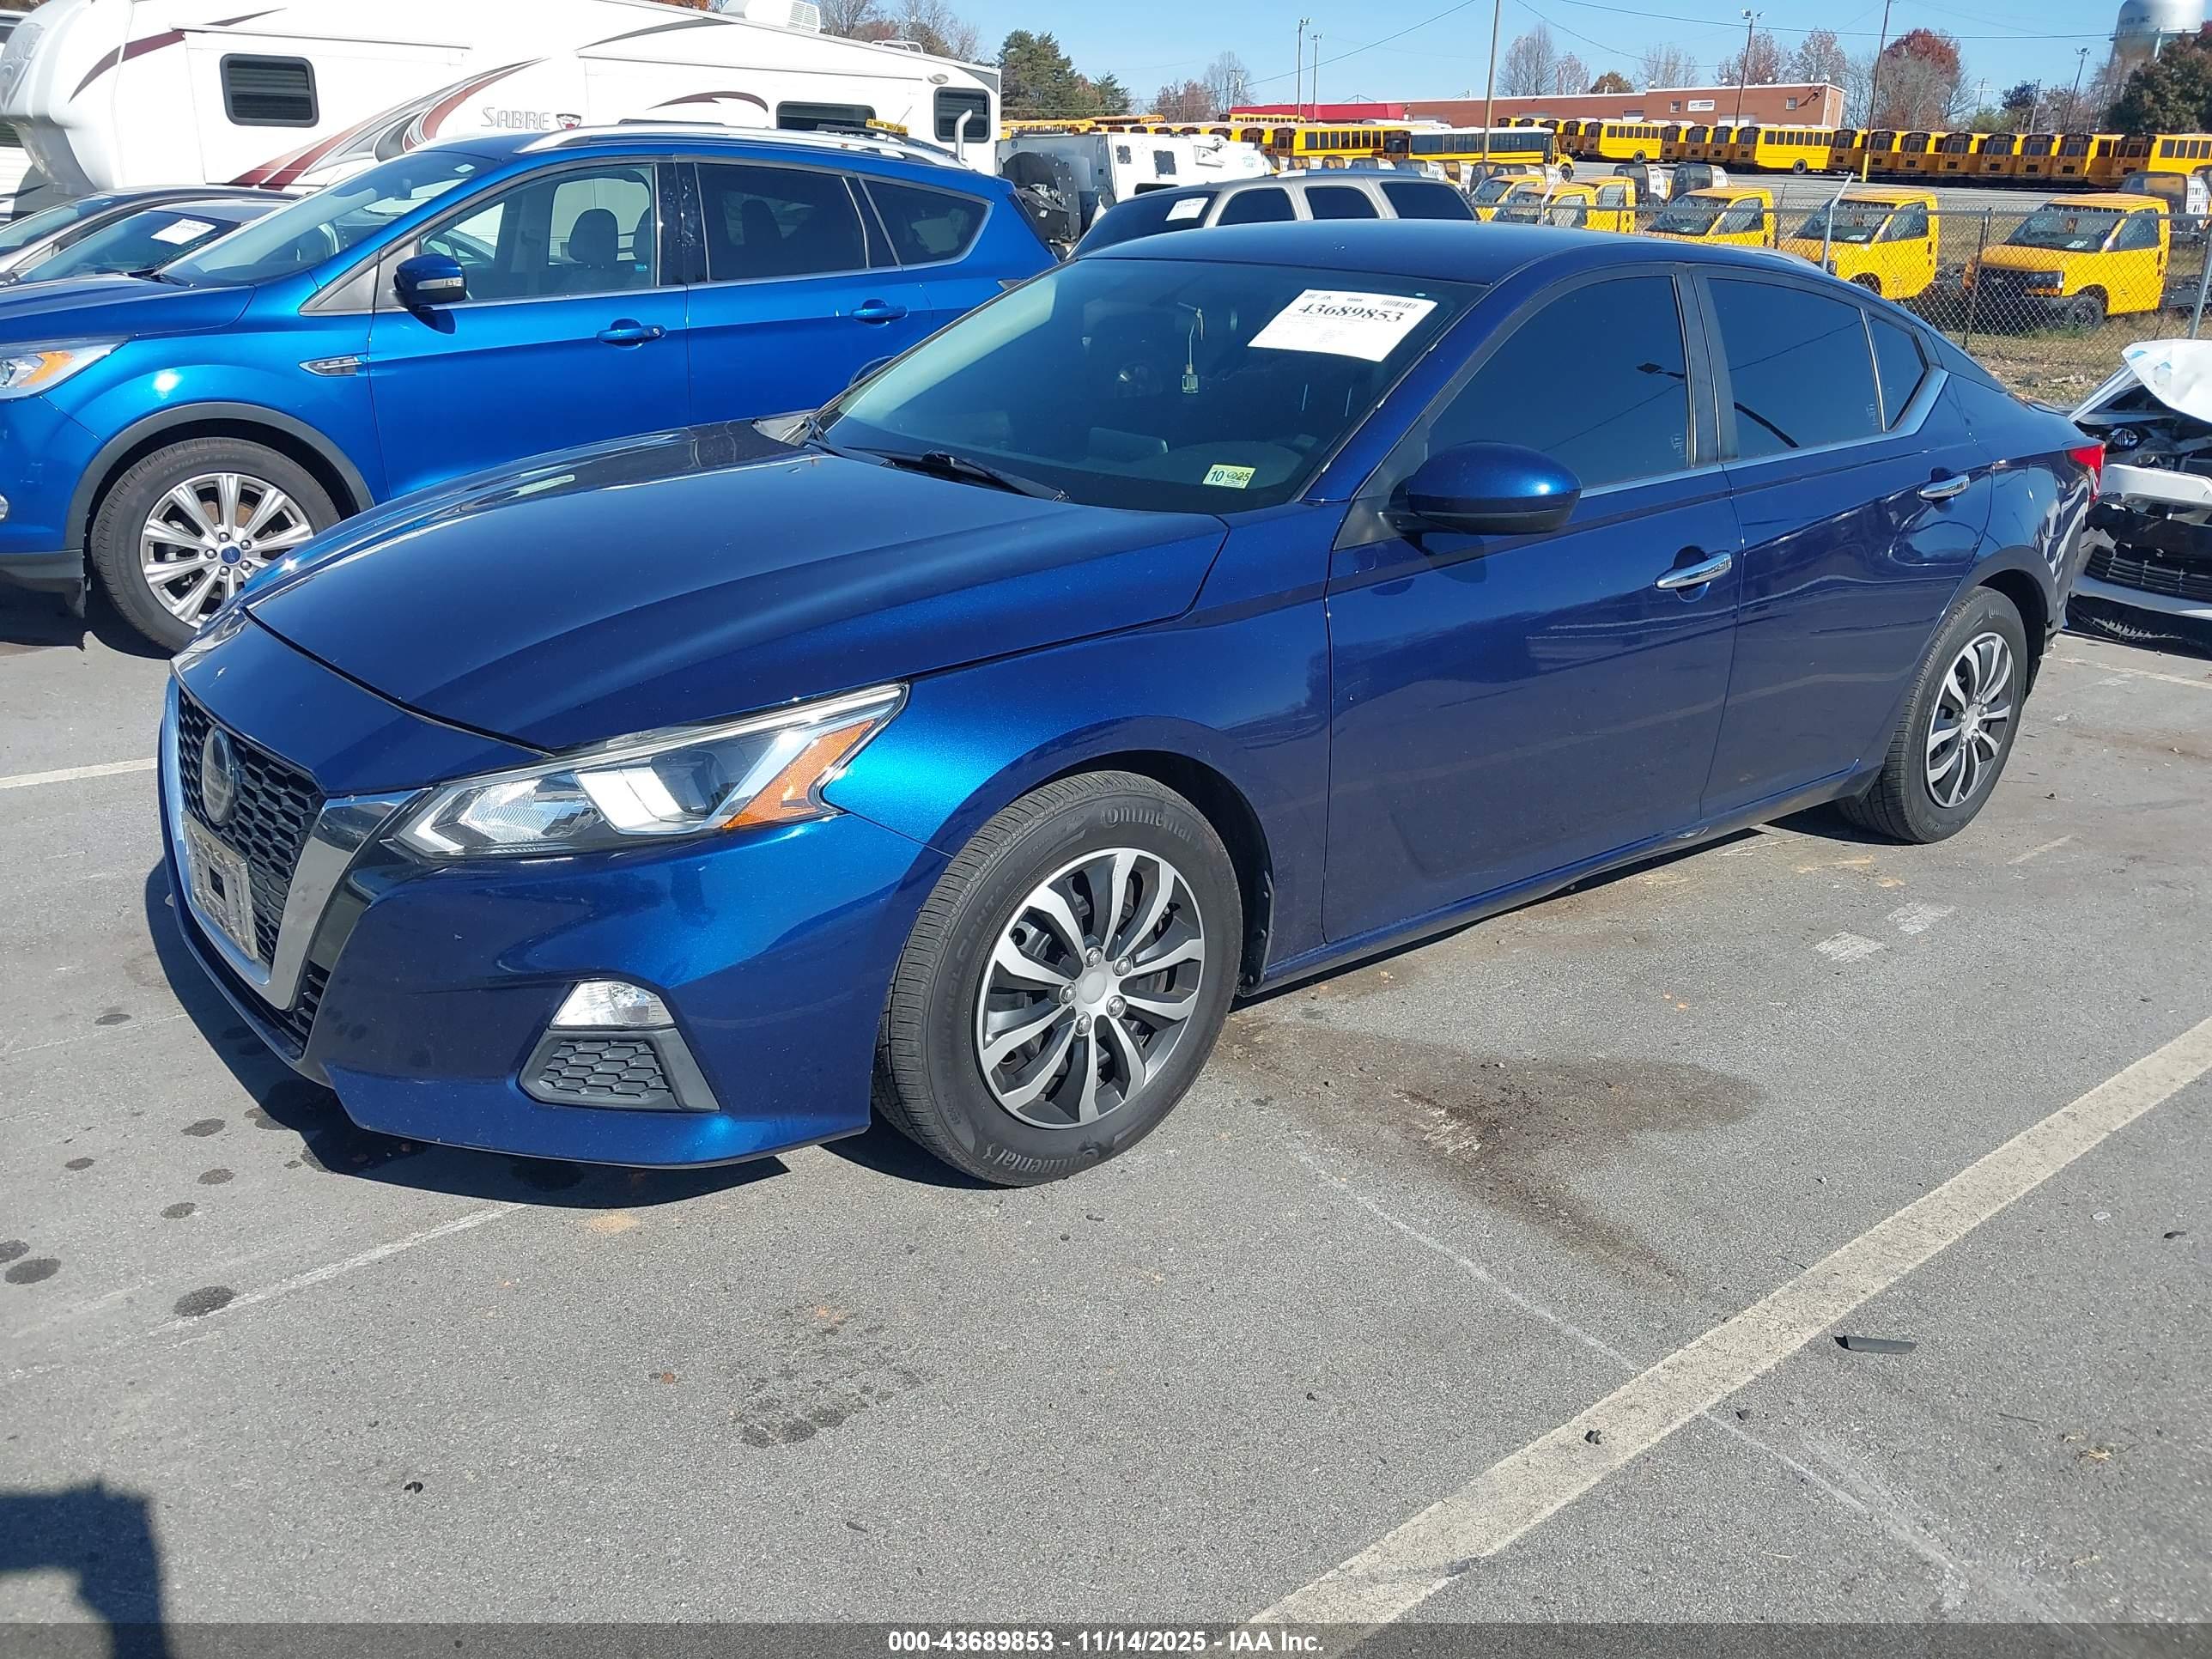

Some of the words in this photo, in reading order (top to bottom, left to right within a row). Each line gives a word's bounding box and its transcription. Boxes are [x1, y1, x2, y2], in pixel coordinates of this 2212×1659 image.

[481, 107, 550, 131] SABRE
[1297, 302, 1405, 323] 43689853
[1210, 470, 1224, 482] 10
